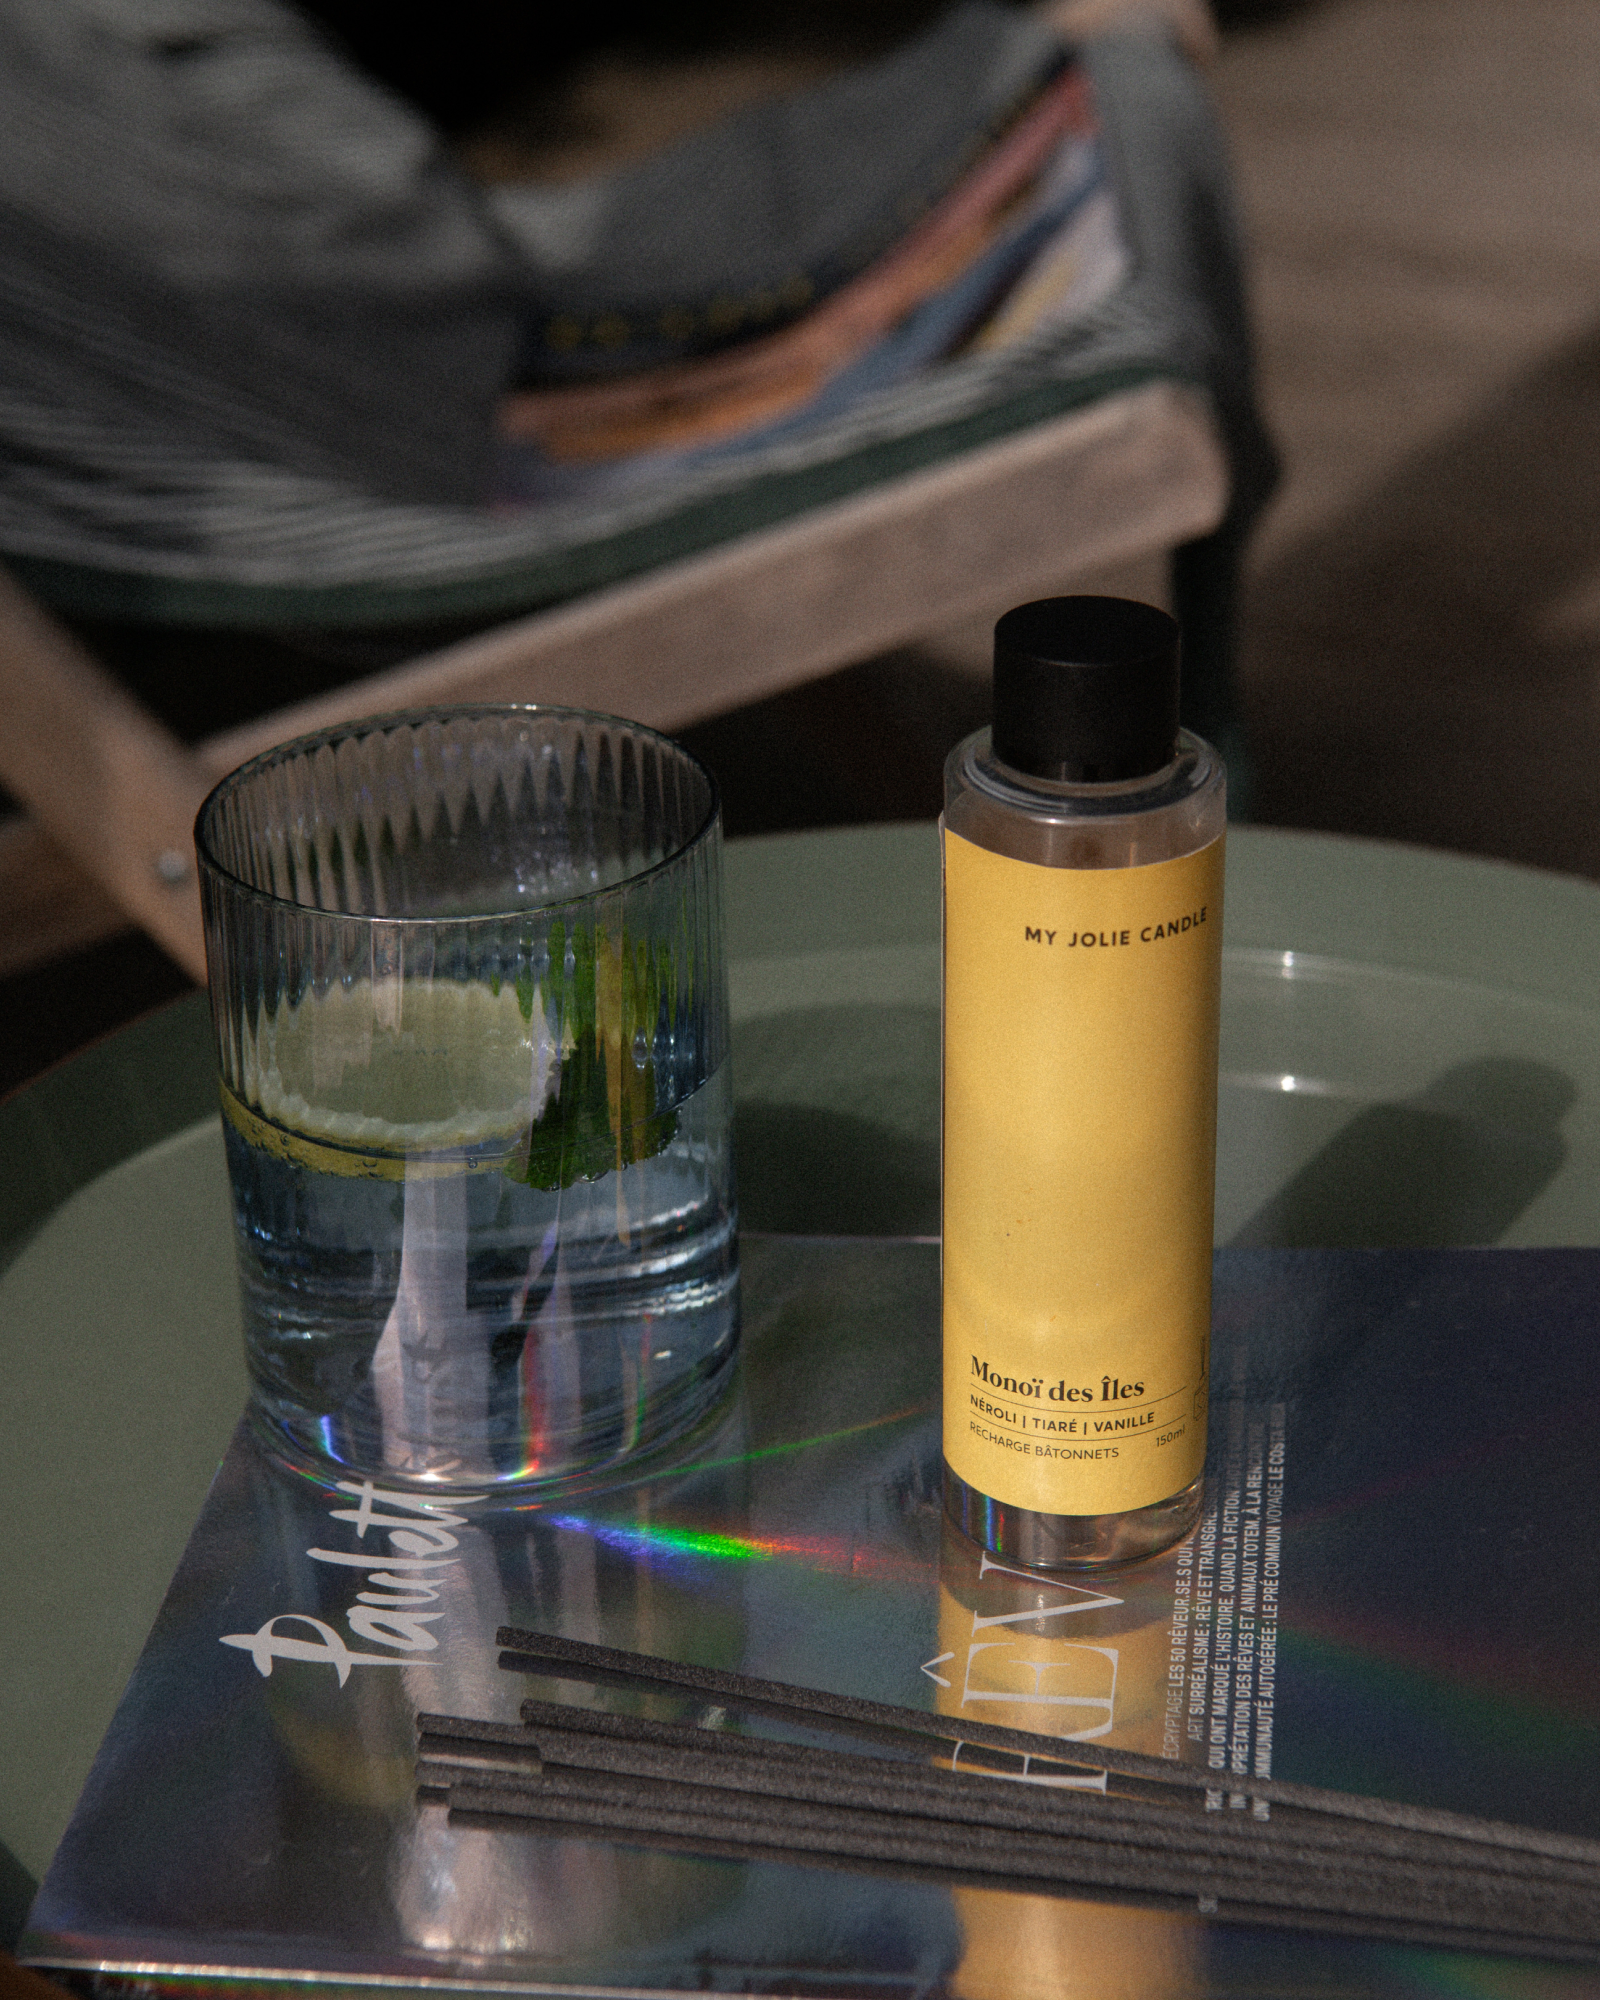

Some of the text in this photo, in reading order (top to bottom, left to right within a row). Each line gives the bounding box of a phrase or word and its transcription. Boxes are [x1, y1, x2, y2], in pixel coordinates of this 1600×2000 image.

[1025, 906, 1207, 947] MY JOLIE CANDLE
[970, 1354, 1145, 1402] Monoï des Îles
[970, 1394, 1017, 1424] NÉROLI
[1032, 1417, 1077, 1433] TIARÉ
[1094, 1412, 1155, 1433] VANILLE
[970, 1421, 1120, 1460] RECHARGE BÂTONNETS
[1155, 1424, 1186, 1447] 150ml
[1268, 1466, 1285, 1480] LE
[1222, 1490, 1240, 1533] FICTION
[1240, 1507, 1261, 1515] À
[1246, 1490, 1262, 1505] LA
[1266, 1482, 1284, 1524] VOYAGE
[1178, 1547, 1194, 1566] QUI
[1222, 1536, 1238, 1550] LA
[1264, 1526, 1282, 1577] COMMUN
[219, 1481, 490, 1689] Paulett
[1198, 1573, 1213, 1588] ET
[1219, 1553, 1237, 1592] QUAND
[1240, 1560, 1258, 1614] ANIMAUX
[1259, 1579, 1279, 1601] PRÉ
[1191, 1591, 1212, 1620] RÊVE
[1262, 1604, 1279, 1619] LE
[1239, 1614, 1255, 1630] ET
[1171, 1648, 1186, 1662] 50
[1233, 1632, 1254, 1672] RÊVES
[1256, 1627, 1277, 1698] AUTOGÉRÉE
[1169, 1664, 1186, 1687] LES
[1187, 1629, 1209, 1715] SURRÉALISME
[1235, 1674, 1252, 1698] DES
[1210, 1663, 1230, 1716] MARQUÉ
[1160, 1688, 1183, 1760] ÉCRYPTAGE
[1188, 1715, 1204, 1742] ART
[1210, 1717, 1227, 1744] ONT
[1208, 1745, 1226, 1769] QUI
